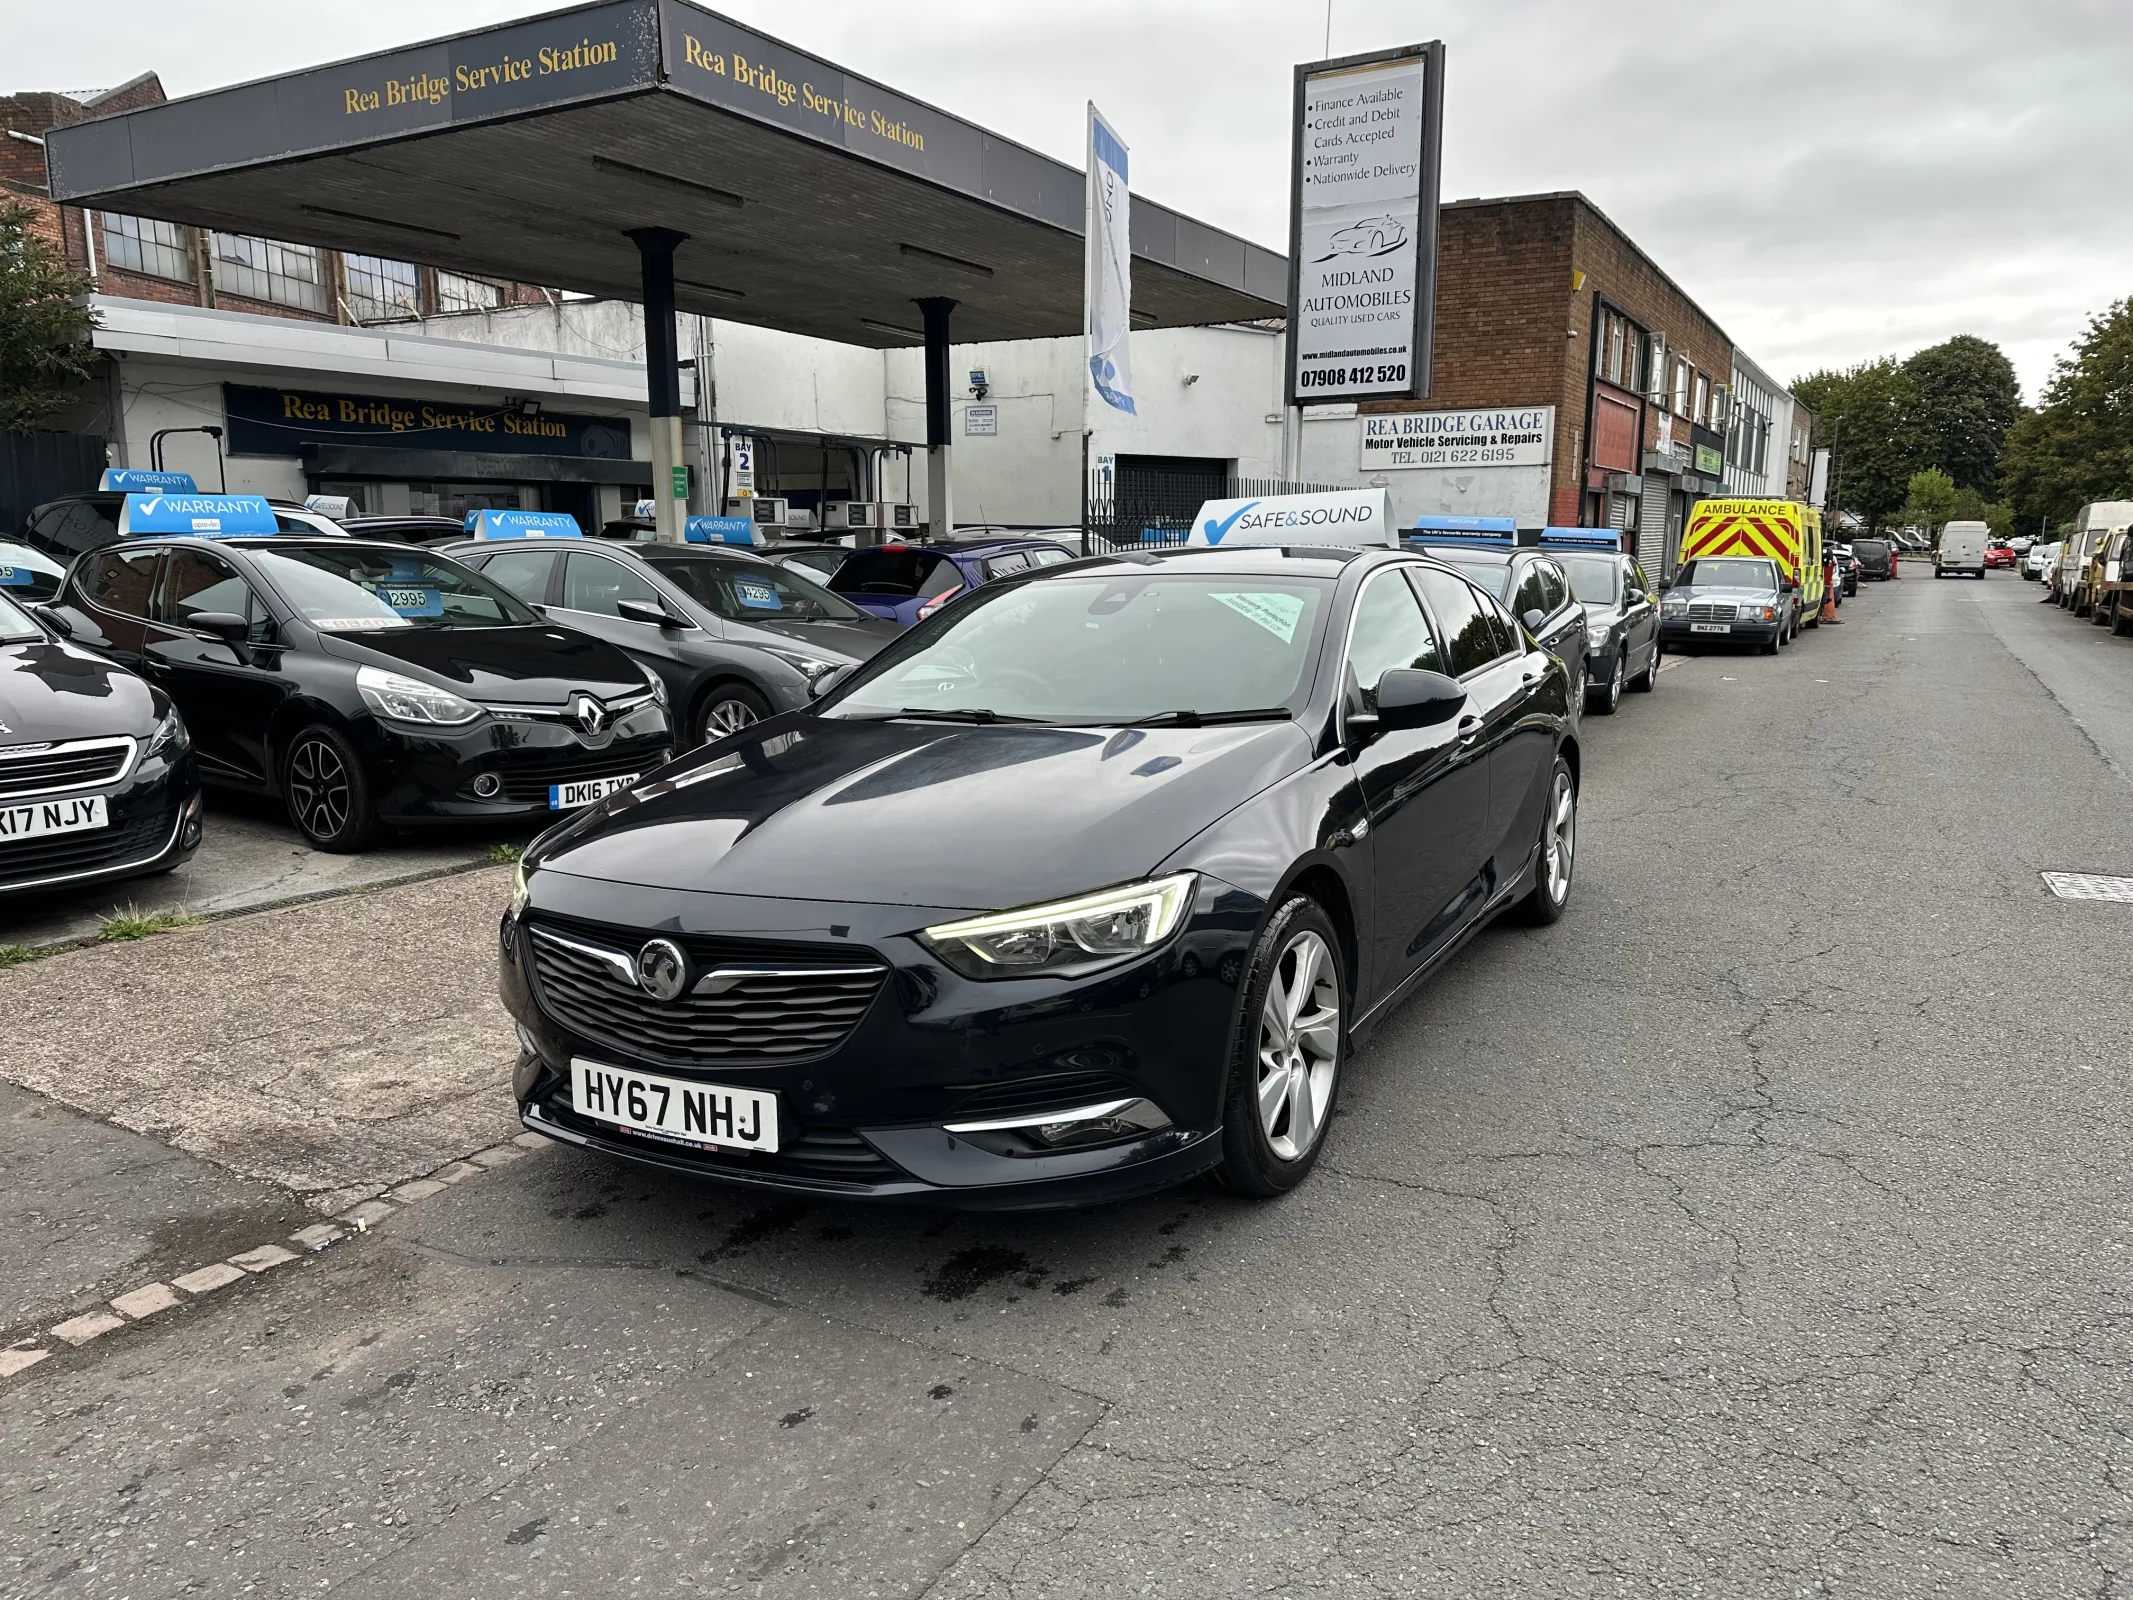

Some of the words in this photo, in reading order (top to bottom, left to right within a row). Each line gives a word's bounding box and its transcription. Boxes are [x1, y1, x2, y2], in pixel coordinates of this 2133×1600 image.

[345, 89, 379, 114] Rea
[386, 73, 449, 104] Bridge
[455, 55, 532, 92] Service
[538, 37, 617, 76] Station
[683, 34, 725, 76] Rea
[733, 54, 796, 106] Bridge
[803, 83, 865, 128] Service
[871, 110, 924, 151] Station
[1315, 97, 1353, 112] Finance
[1356, 88, 1403, 105] Available
[1314, 116, 1345, 130] Credit
[1348, 111, 1367, 126] and
[1371, 107, 1400, 122] Debit
[1314, 135, 1343, 149] Cards
[1345, 126, 1395, 145] Accepted
[1313, 152, 1359, 167] Warranty
[1313, 167, 1370, 185] Nationwide
[1373, 163, 1417, 178] Delivery
[1321, 267, 1394, 288] MIDLAND
[1303, 289, 1411, 312] AUTOMOBILES
[1310, 316, 1348, 328] QUALITY
[1350, 313, 1375, 324] USED
[1377, 311, 1401, 321] CARS
[1302, 345, 1407, 360] www.midlandautomobiles.co.uk
[1301, 368, 1346, 388] 07908
[1348, 366, 1374, 384] 412
[1377, 364, 1406, 382] 520
[283, 395, 330, 420] Rea
[340, 400, 415, 432] Bridge
[422, 407, 495, 430] Service
[504, 413, 566, 437] Station
[1366, 419, 1398, 436] REA
[1402, 415, 1466, 434] BRIDGE
[1470, 412, 1543, 431] GARAGE
[735, 443, 751, 452] BAY
[1365, 438, 1394, 450] Motor
[1396, 436, 1435, 449] Vehicle
[1438, 434, 1487, 448] Servicing
[1490, 435, 1498, 445] &
[1501, 432, 1542, 446] Repairs
[740, 453, 749, 470] 2
[1391, 451, 1417, 464] TEL.
[1421, 451, 1446, 463] 0121
[1451, 450, 1477, 462] 622
[1481, 448, 1515, 462] 6195
[128, 473, 188, 486] WARRANTY
[1102, 466, 1109, 481] 1
[163, 500, 261, 514] WARRANTY
[1240, 506, 1372, 529] SAFE&SOUND
[1703, 504, 1787, 516] AMBULANCE
[506, 514, 571, 528] WARRANTY
[701, 520, 747, 531] WARRANTY
[565, 782, 601, 804] DK16
[43, 799, 95, 829] NJY
[585, 1069, 670, 1126] HY67
[683, 1090, 760, 1142] NHJ
